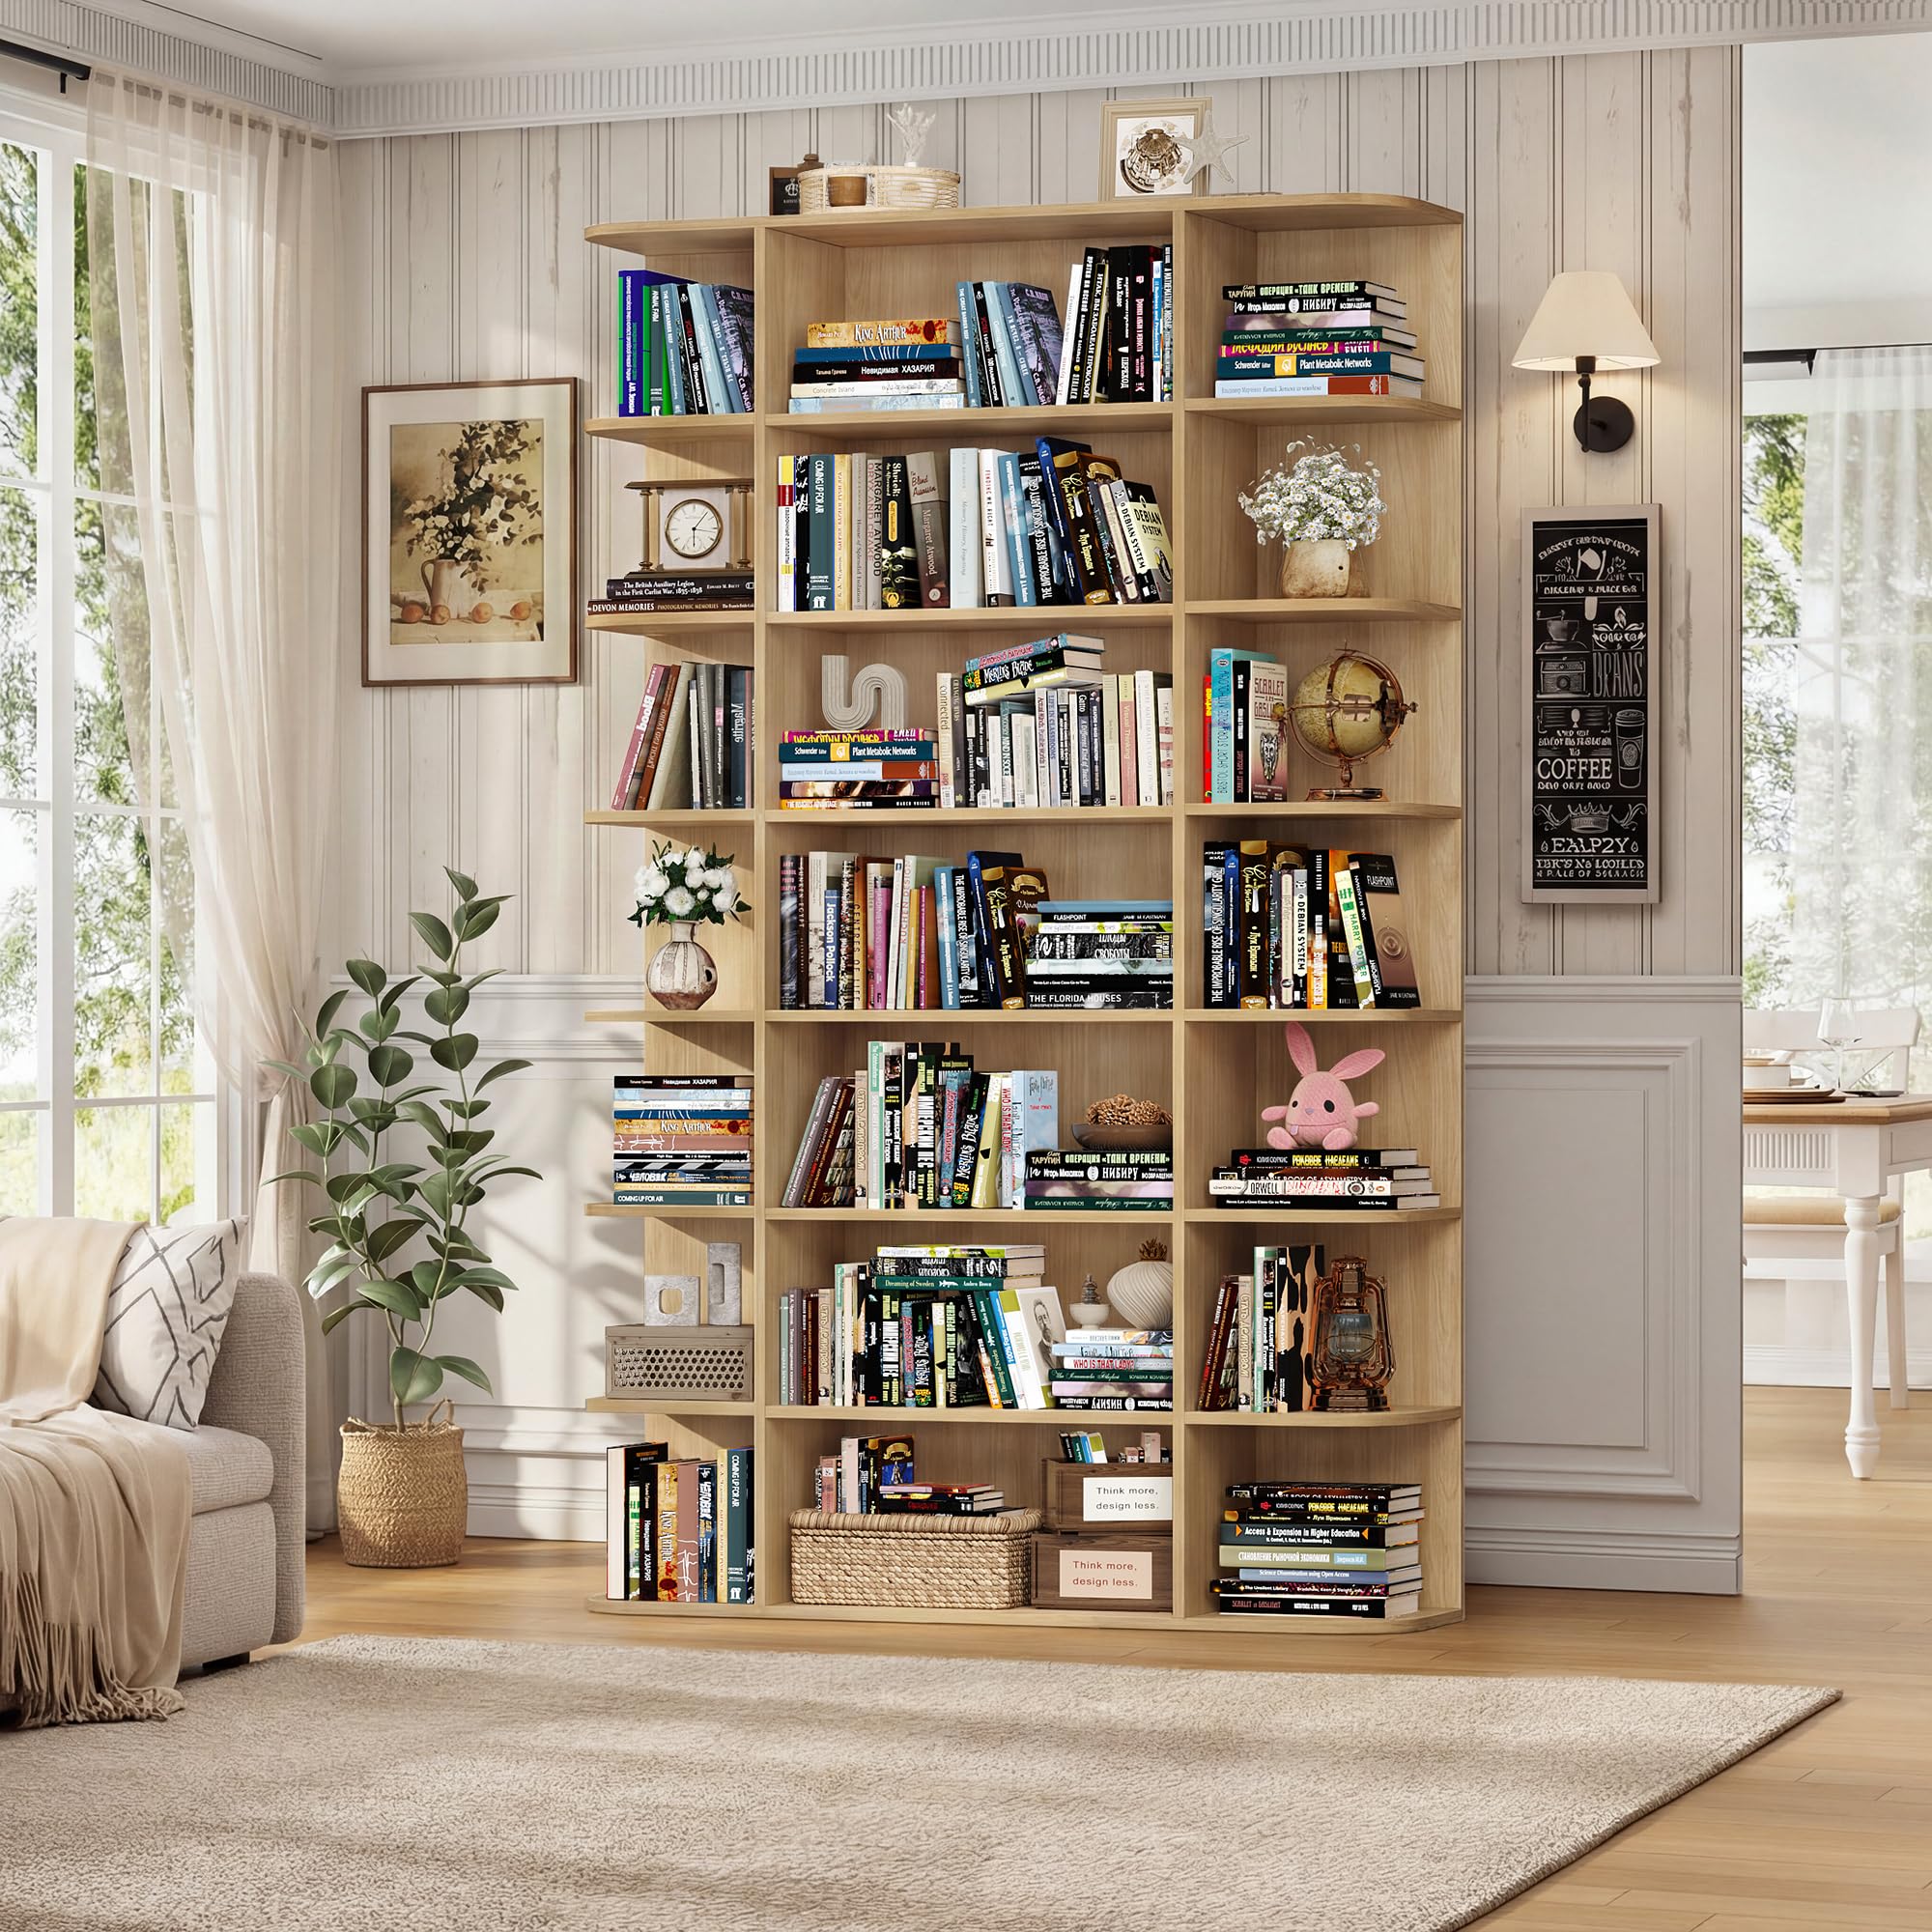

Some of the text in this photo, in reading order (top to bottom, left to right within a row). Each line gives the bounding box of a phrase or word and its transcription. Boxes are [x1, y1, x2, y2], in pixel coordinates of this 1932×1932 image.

[1093, 298, 1100, 311] ВЫ
[854, 324, 873, 342] KING
[861, 364, 935, 376] Невидимая ХАЗАРИЯ
[1235, 360, 1262, 370] Schwender
[1299, 359, 1315, 370] Plant
[1316, 358, 1344, 370] Metabolic
[1345, 356, 1373, 368] Networks
[1083, 355, 1094, 399] ПРОКАЗОЙ
[892, 462, 902, 497] Shriek:
[873, 463, 882, 577] MARGARET ATWOOD
[922, 509, 937, 576] Margaret Atwood
[1122, 508, 1146, 569] DEBIAN SYSTEM
[654, 581, 676, 589] Auxiliary
[592, 604, 616, 612] DEVON
[618, 603, 654, 611] MEMORIES
[939, 685, 950, 730] connected
[1078, 695, 1087, 712] Gatto
[866, 747, 893, 755] Metabolic
[1537, 758, 1612, 780] COFFEE
[954, 874, 965, 886] THE
[1367, 875, 1395, 887] FLASHPOINT
[955, 887, 967, 920] IMPROBABLE
[957, 921, 967, 931] RISE
[825, 902, 836, 981] Jackson Pollock
[1350, 913, 1368, 977] HARRY POTTER
[853, 959, 861, 972] OF
[959, 941, 970, 976] SINGULARITY
[1369, 959, 1381, 994] FLASHPOINT
[1088, 994, 1122, 1003] HOUSES
[1002, 1088, 1011, 1104] WHO
[660, 1121, 679, 1132] KING
[1003, 1113, 1011, 1130] THAT
[1003, 1132, 1011, 1153] LADY?
[918, 1151, 934, 1168] ПЕС
[1102, 1167, 1138, 1180] НИБИРУ
[1250, 1182, 1279, 1194] ORWELL
[992, 1350, 1002, 1366] Sweden
[1090, 1359, 1095, 1368] IS
[1096, 1359, 1113, 1368] THAT
[1115, 1359, 1134, 1369] LADY?
[997, 1370, 1008, 1392] Dreaming
[1096, 1487, 1125, 1495] Think
[1096, 1502, 1130, 1511] design
[662, 1510, 676, 1529] KING
[1244, 1526, 1264, 1536] Access
[1272, 1527, 1302, 1538] Expansion
[1303, 1527, 1310, 1536] in
[1310, 1527, 1330, 1538] Higher
[1331, 1528, 1360, 1538] Education
[1238, 1551, 1272, 1561] СТАНОВЛЕНИЕ
[1272, 1552, 1300, 1563] РЫНОЧНОЙ
[1072, 1561, 1137, 1571] Think more,
[1072, 1577, 1138, 1587] design less.
